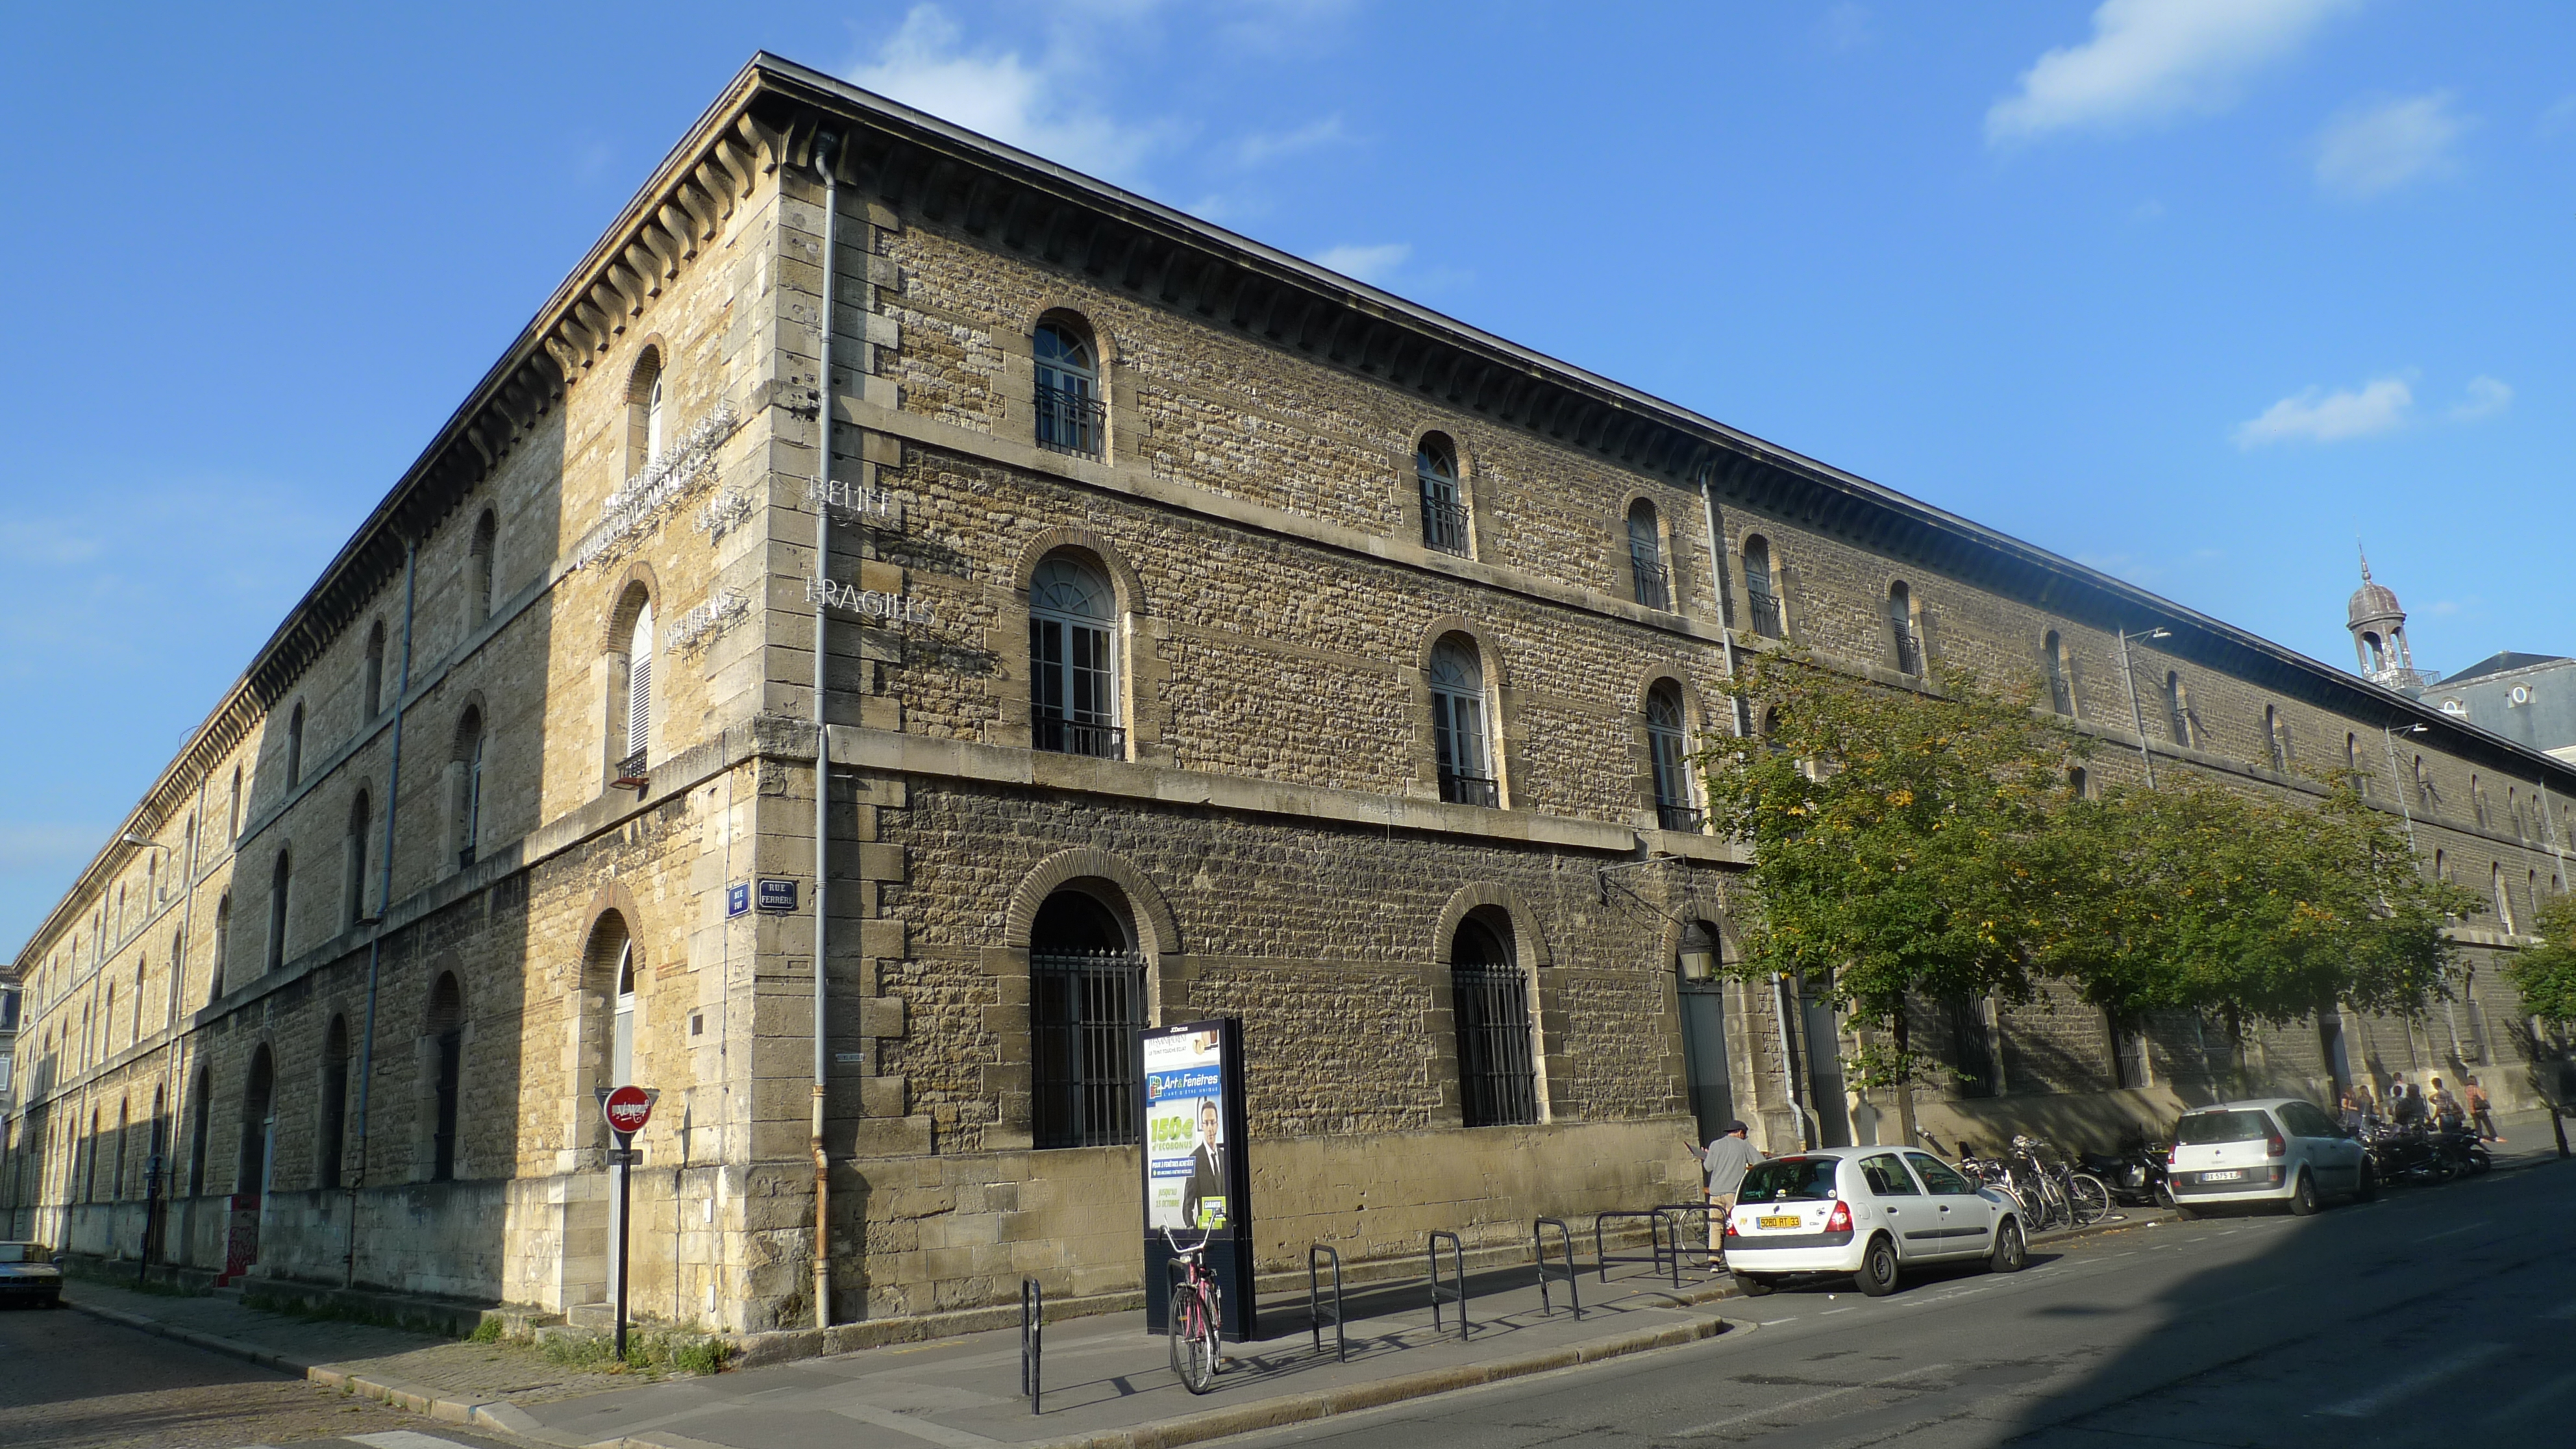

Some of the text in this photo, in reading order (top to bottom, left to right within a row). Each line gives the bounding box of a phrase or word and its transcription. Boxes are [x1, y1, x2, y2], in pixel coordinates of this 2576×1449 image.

[805, 575, 935, 625] FRAGILES
[769, 884, 786, 892] RUE
[1151, 1116, 1195, 1143] 150€
[1790, 1217, 1799, 1226] 33
